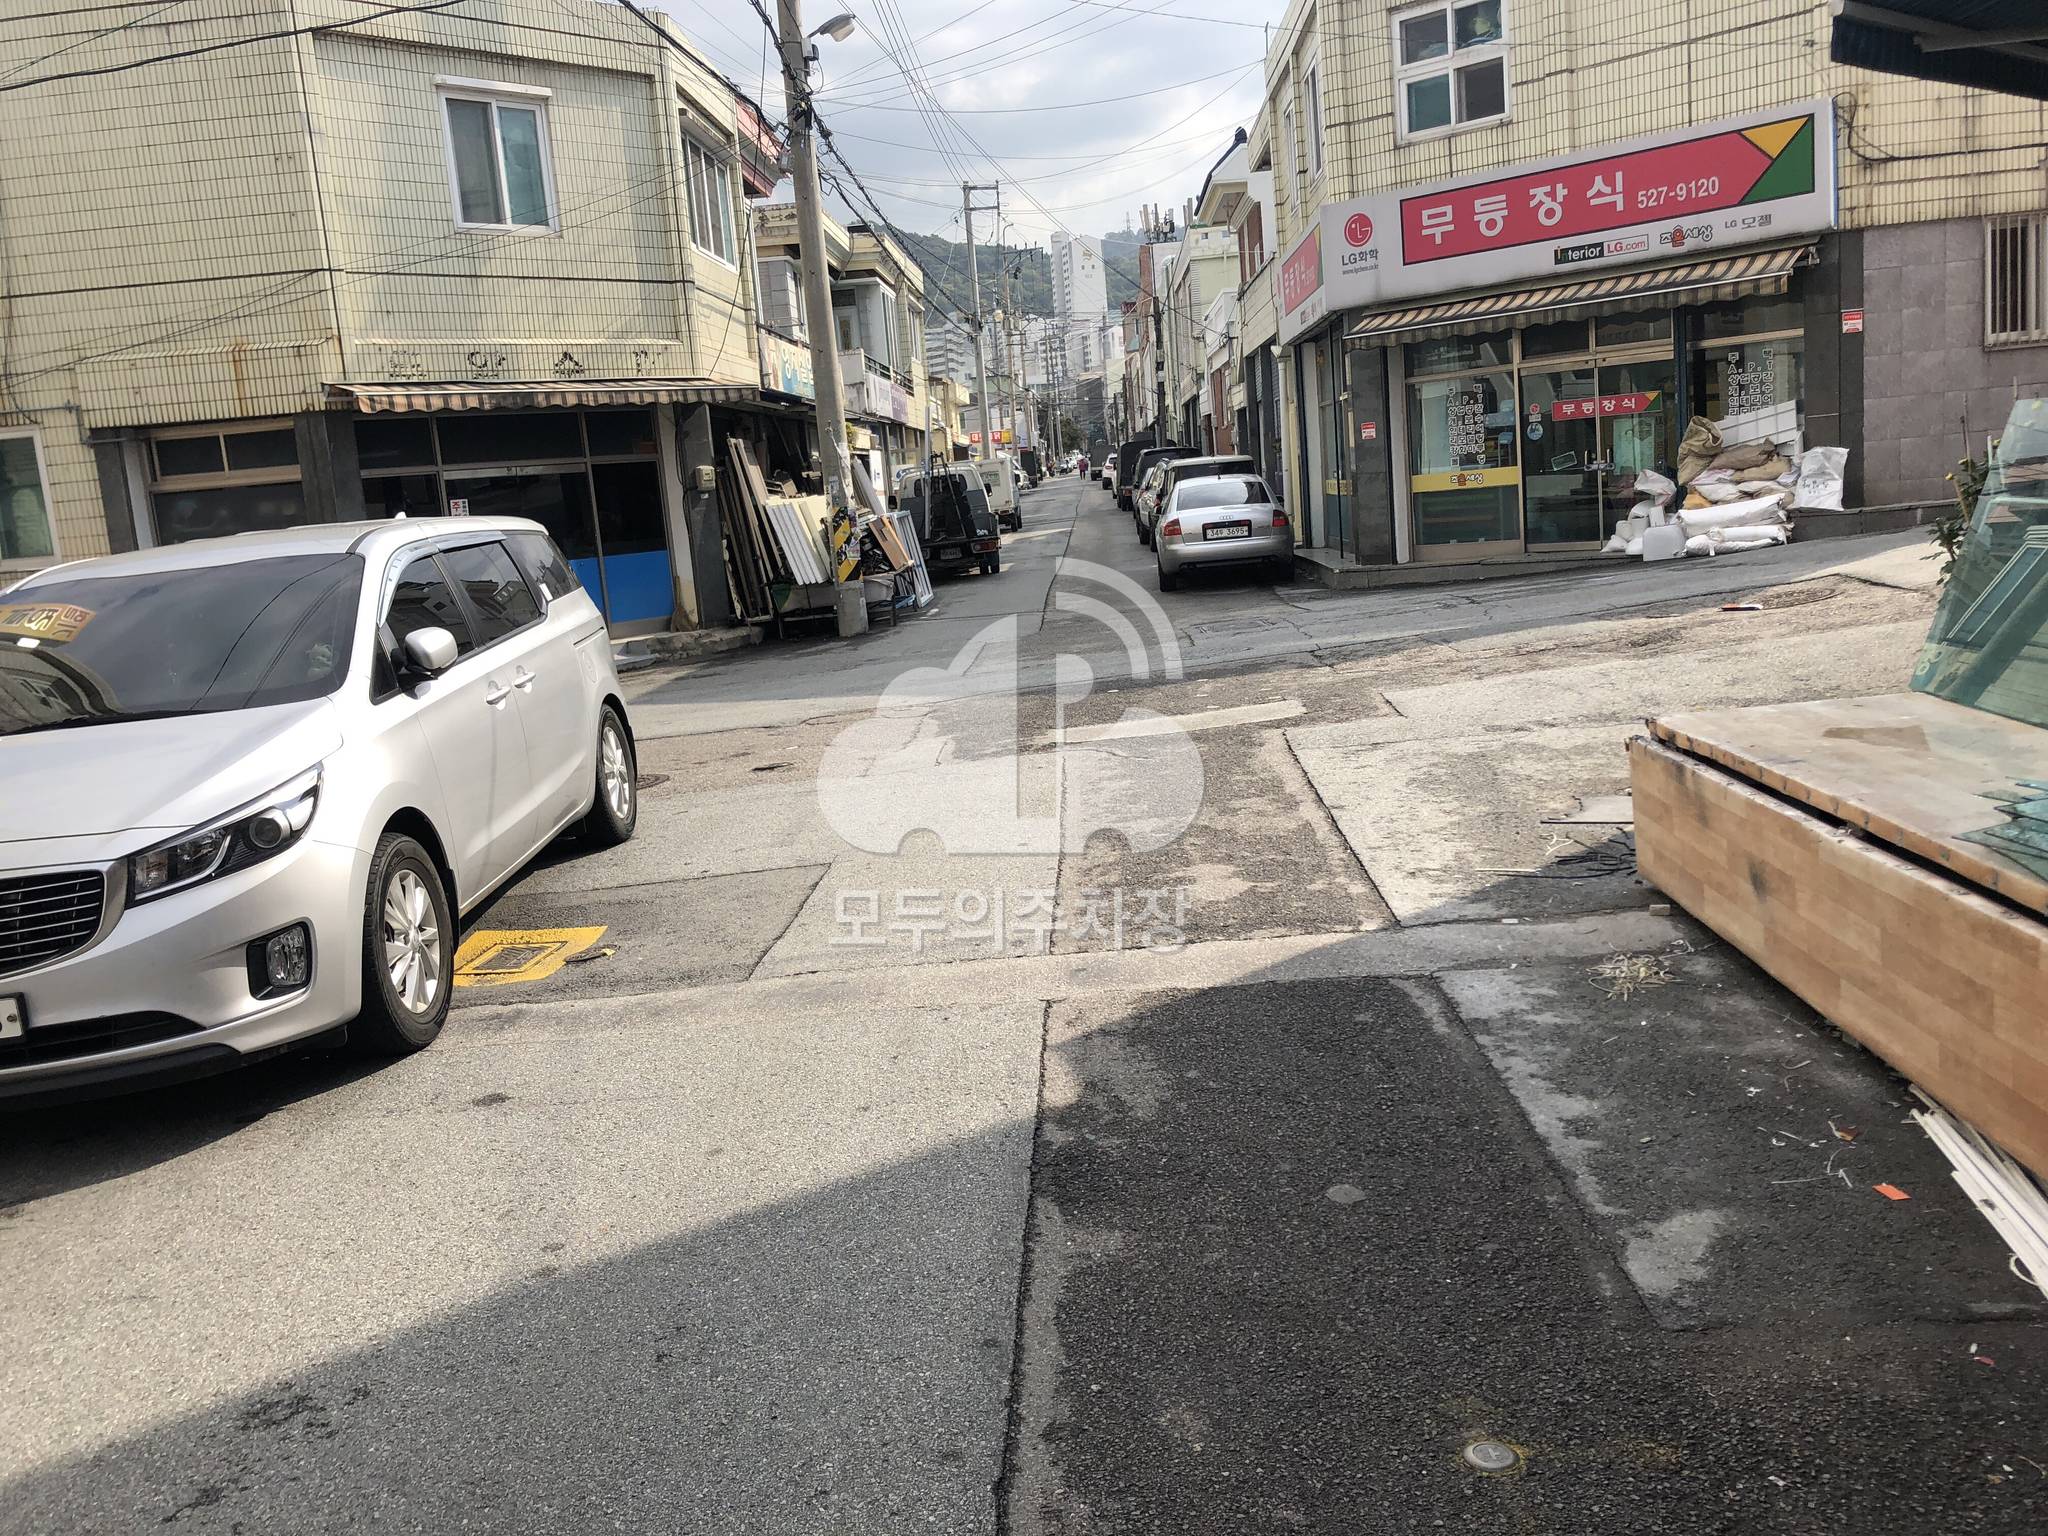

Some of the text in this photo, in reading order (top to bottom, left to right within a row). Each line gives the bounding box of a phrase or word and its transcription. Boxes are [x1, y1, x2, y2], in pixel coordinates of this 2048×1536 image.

[1637, 176, 1720, 210] 527-9120
[1724, 219, 1738, 229] LG
[1341, 248, 1380, 266] LG화학
[1562, 397, 1636, 415] 무등장식
[1226, 527, 1245, 536] 3695
